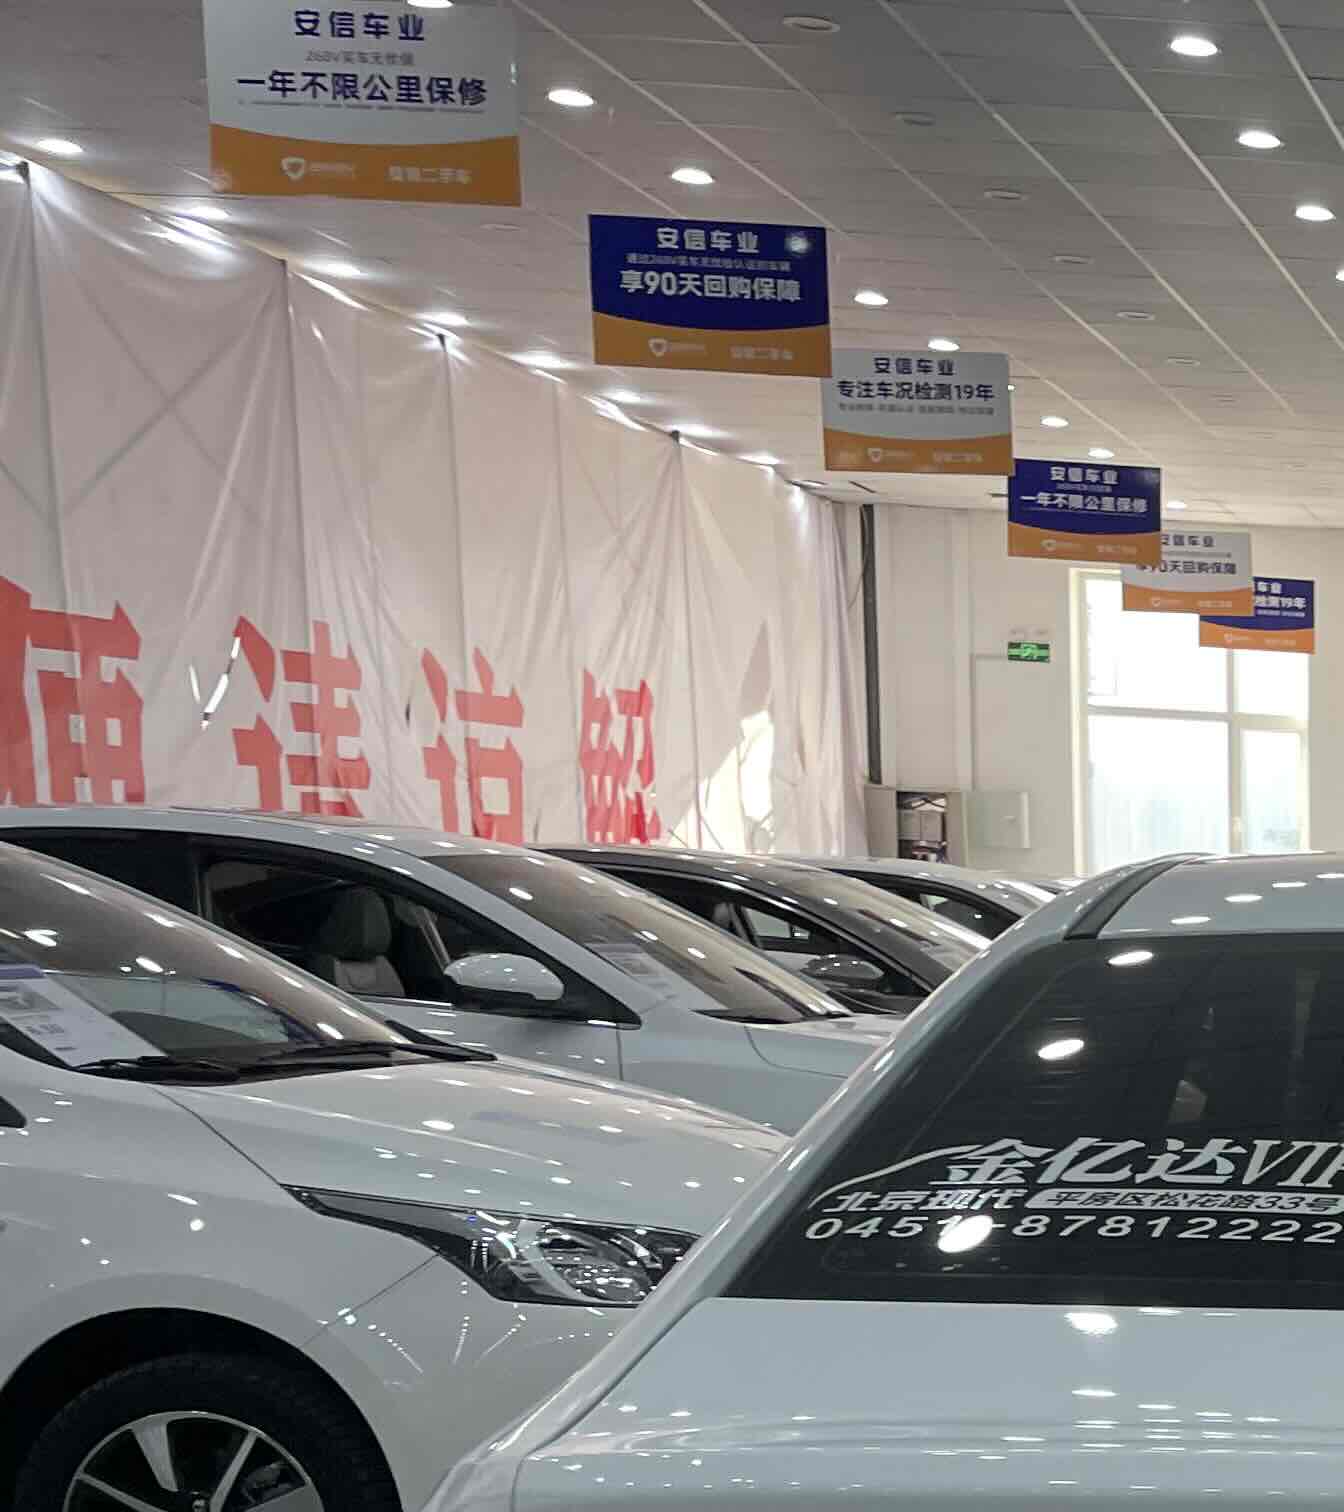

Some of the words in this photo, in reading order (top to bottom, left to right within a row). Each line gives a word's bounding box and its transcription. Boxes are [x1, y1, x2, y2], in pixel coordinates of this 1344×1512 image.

[294, 10, 425, 41] 安信车业
[237, 70, 487, 106] 一年不限公里保修
[656, 226, 760, 254] 安信车业
[619, 269, 802, 302] 享90天回购保障
[873, 356, 955, 377] 安信车业
[836, 380, 996, 402] 专注车况检测19年
[822, 1189, 1028, 1213] 北京现代
